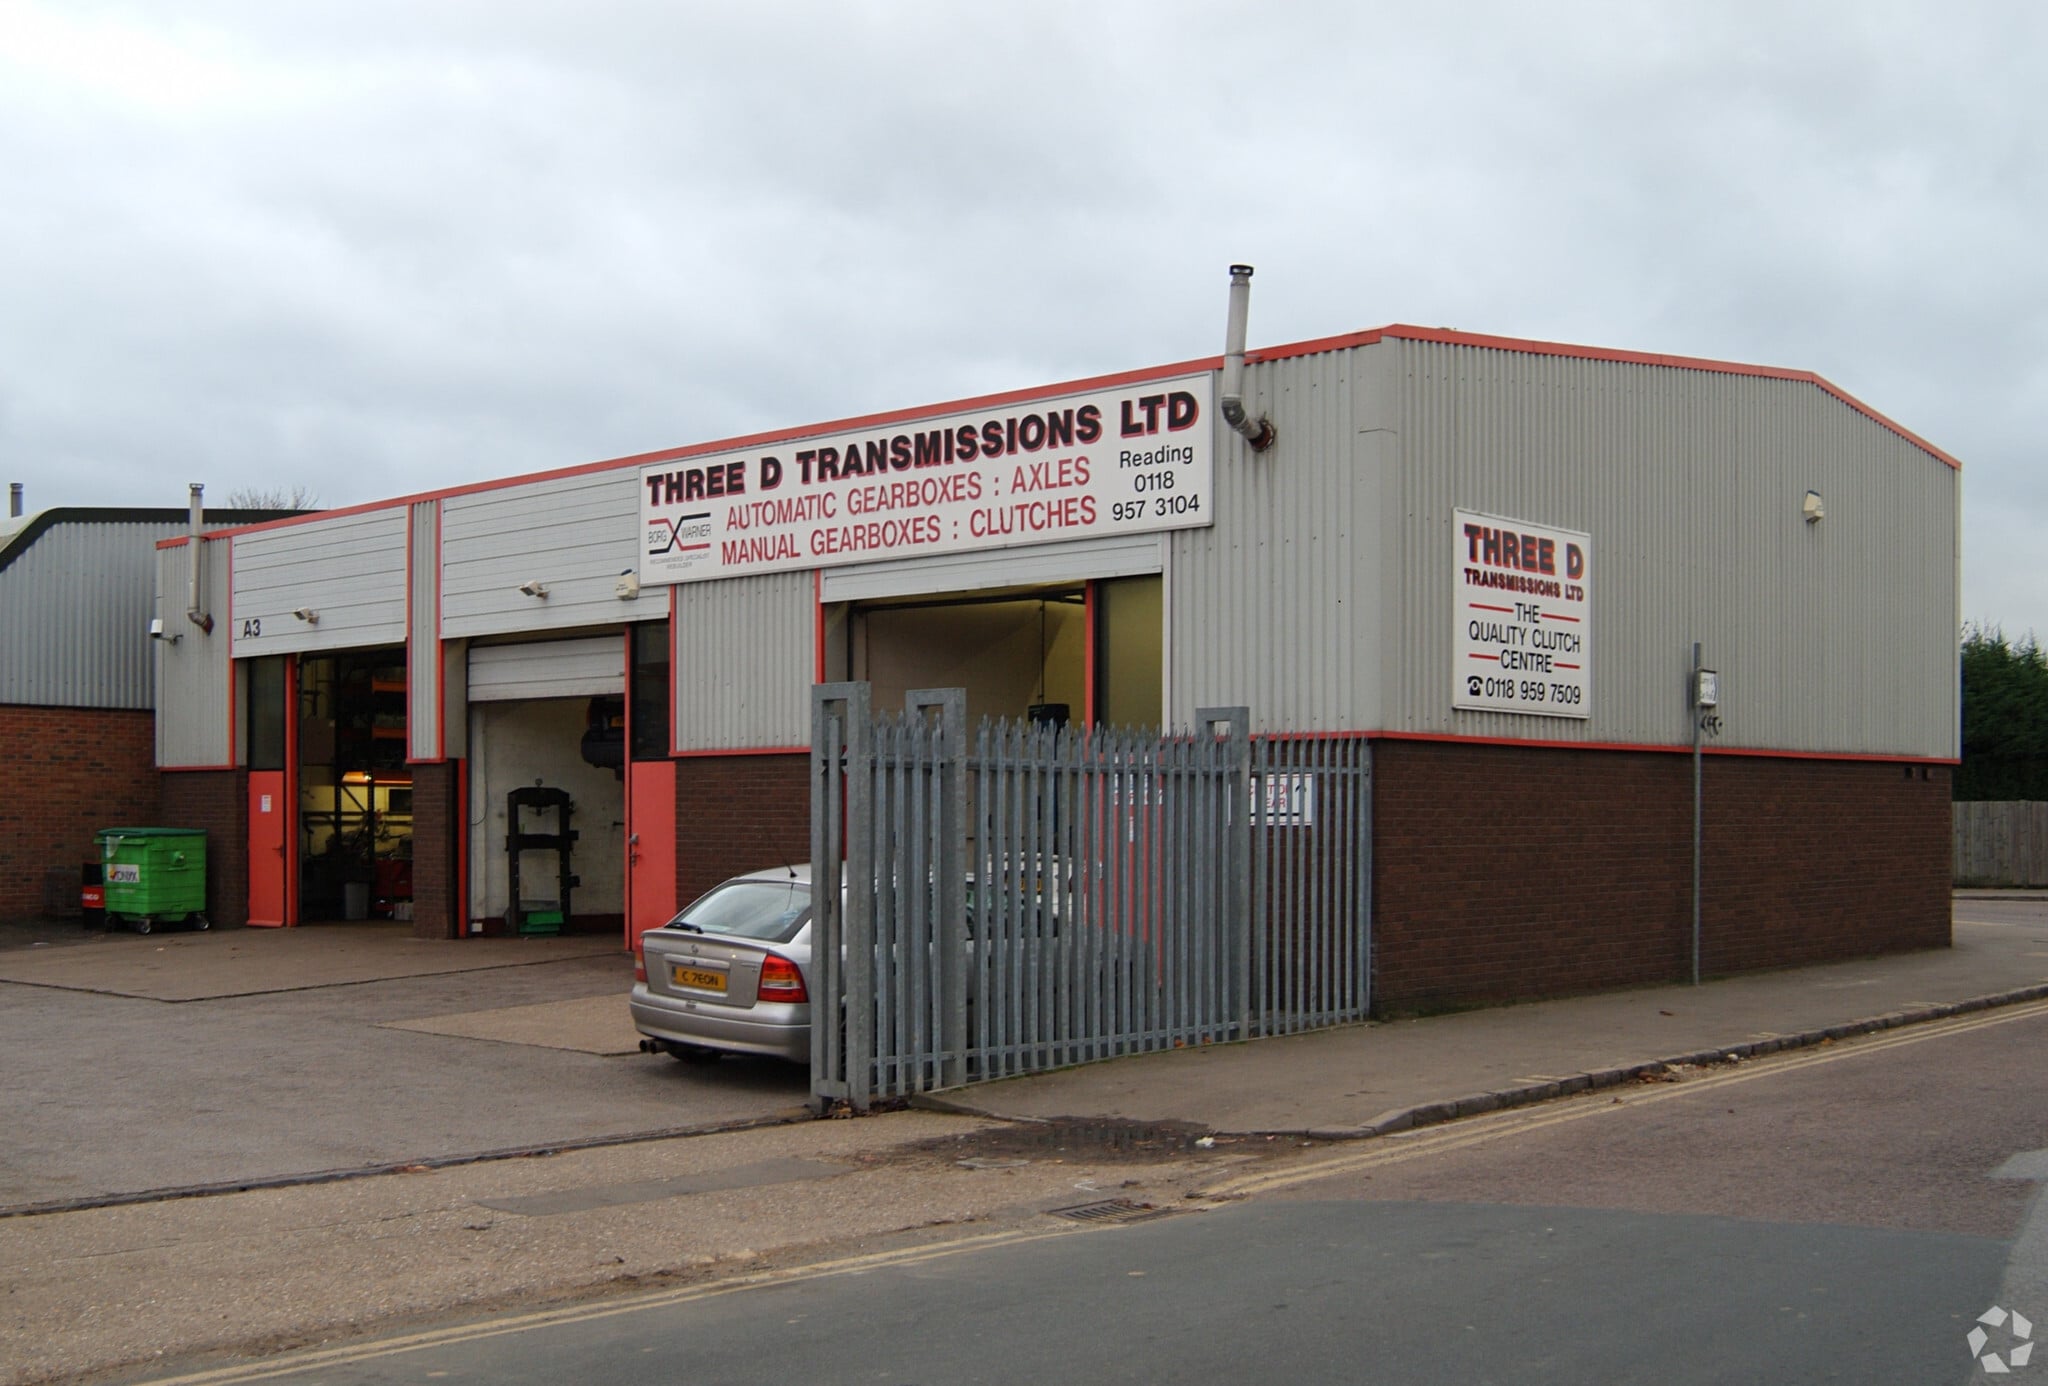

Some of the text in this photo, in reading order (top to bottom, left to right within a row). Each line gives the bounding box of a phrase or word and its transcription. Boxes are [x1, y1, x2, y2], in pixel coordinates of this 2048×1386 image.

[646, 391, 1200, 507] THREE D TRANSMISSIONS LTD
[1119, 445, 1194, 469] Reading
[726, 492, 837, 531] AUTOMATIC
[847, 471, 982, 516] GEARBOXES
[1011, 456, 1091, 494] AXLES
[1134, 471, 1175, 493] 0118
[1112, 494, 1200, 521] 957 3104
[648, 523, 711, 544] BORG WARNER
[721, 533, 802, 566] MANUAL
[810, 514, 941, 556] GEARBOXES
[969, 495, 1097, 538] CLUTCHES
[1464, 523, 1585, 580] THREE D
[1464, 567, 1584, 602] TRANSMISSIONS LTD
[1514, 602, 1540, 624] THE
[243, 618, 261, 638] A3
[1469, 620, 1581, 653] QUALITY CLUTCH
[1500, 649, 1552, 673] CENTRE
[1486, 677, 1581, 705] 0118 959 7509
